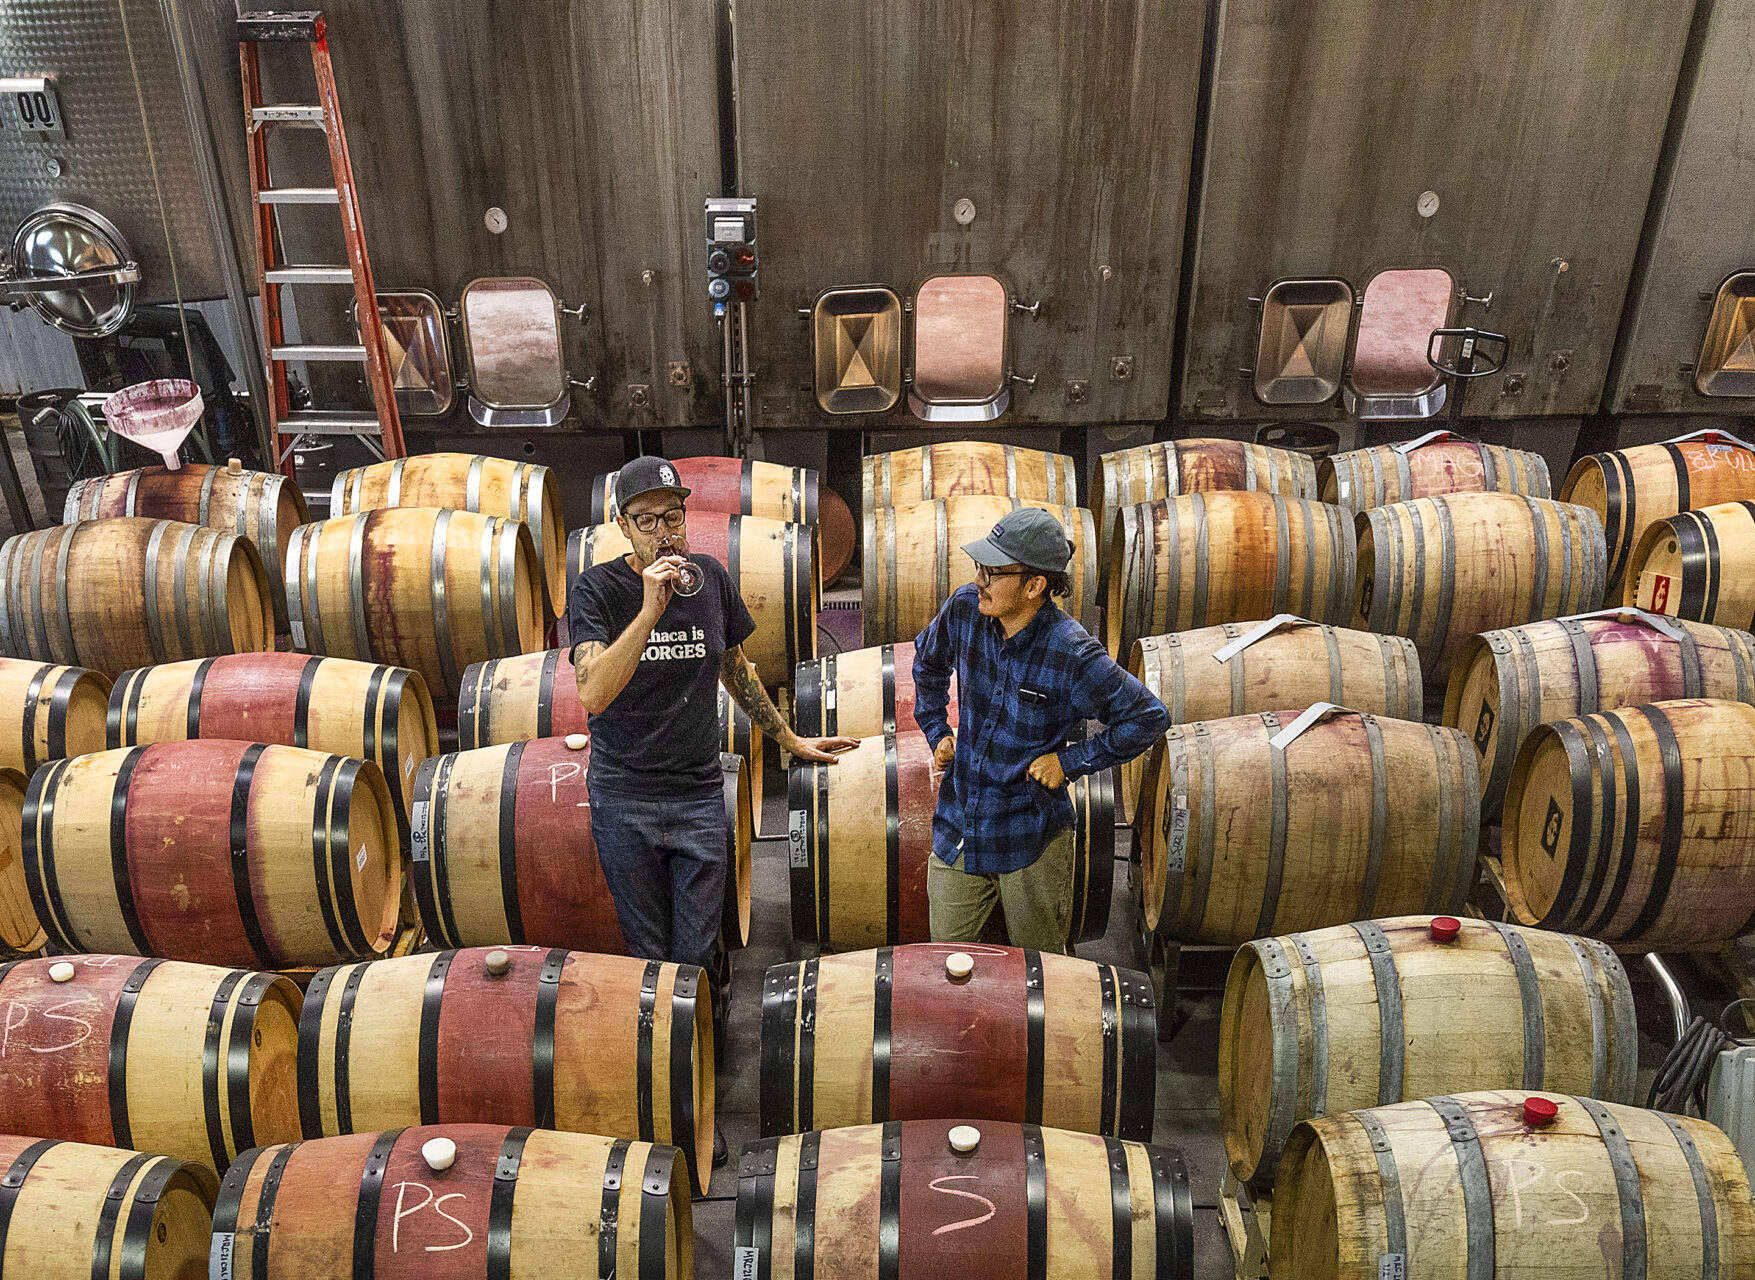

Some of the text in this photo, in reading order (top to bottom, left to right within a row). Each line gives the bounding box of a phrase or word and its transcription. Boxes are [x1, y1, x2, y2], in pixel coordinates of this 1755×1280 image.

[647, 625, 705, 643] haca is
[2, 998, 97, 1058] PS
[392, 1182, 473, 1253] PS
[928, 1175, 997, 1235] S
[1508, 1159, 1590, 1227] PS
